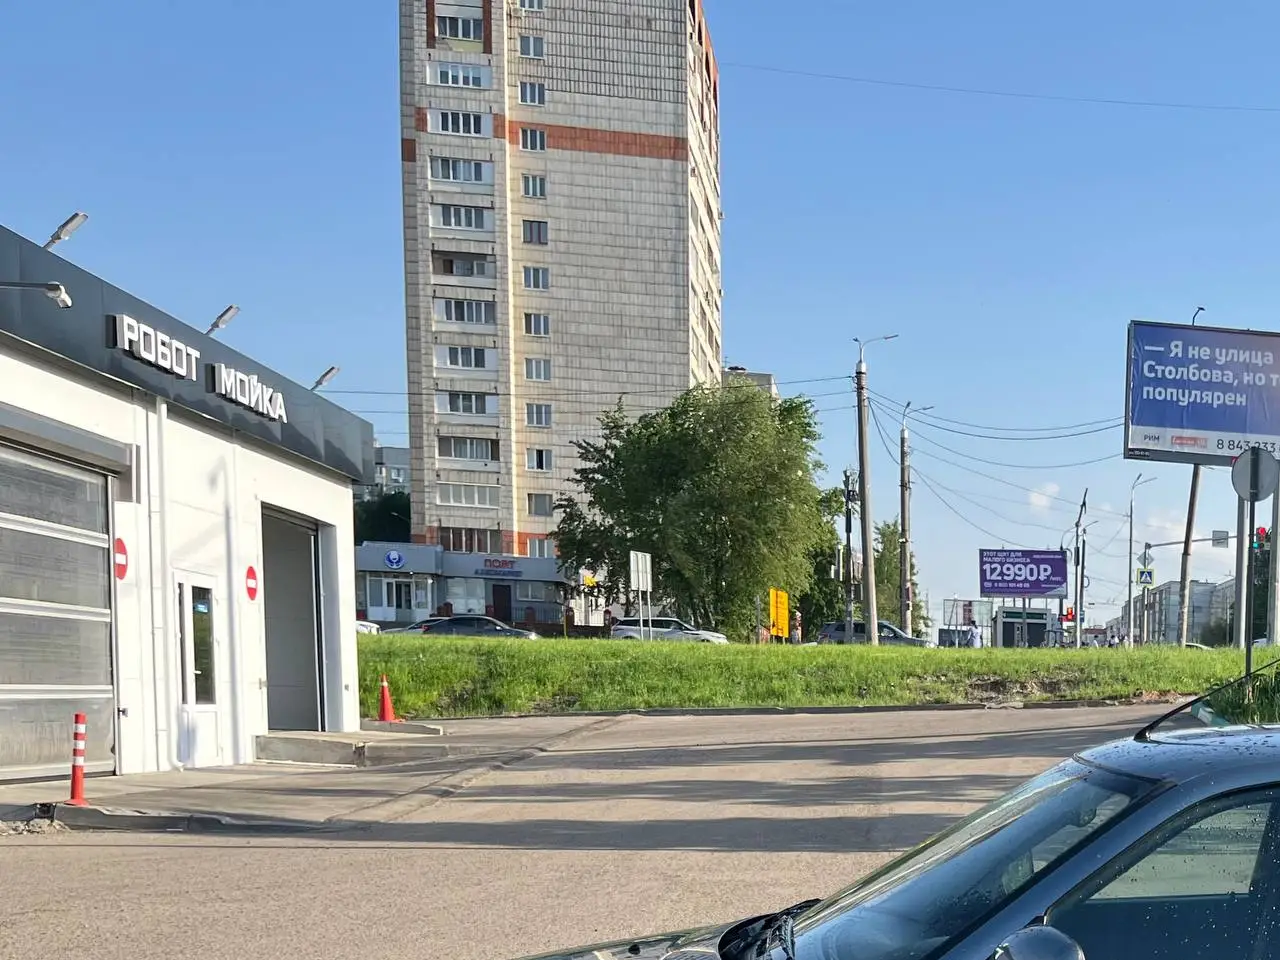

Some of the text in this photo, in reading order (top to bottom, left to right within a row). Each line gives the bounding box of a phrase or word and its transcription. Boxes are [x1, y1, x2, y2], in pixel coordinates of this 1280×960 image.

[1169, 340, 1183, 358] Я
[1188, 345, 1210, 360] не
[1215, 347, 1274, 367] улица
[118, 314, 288, 424] РОБОТ МОЙКА
[1143, 360, 1239, 387] Столбова,
[1243, 373, 1265, 387] но
[1143, 386, 1247, 408] популярен
[1216, 438, 1225, 450] 8
[1227, 439, 1252, 451] 843
